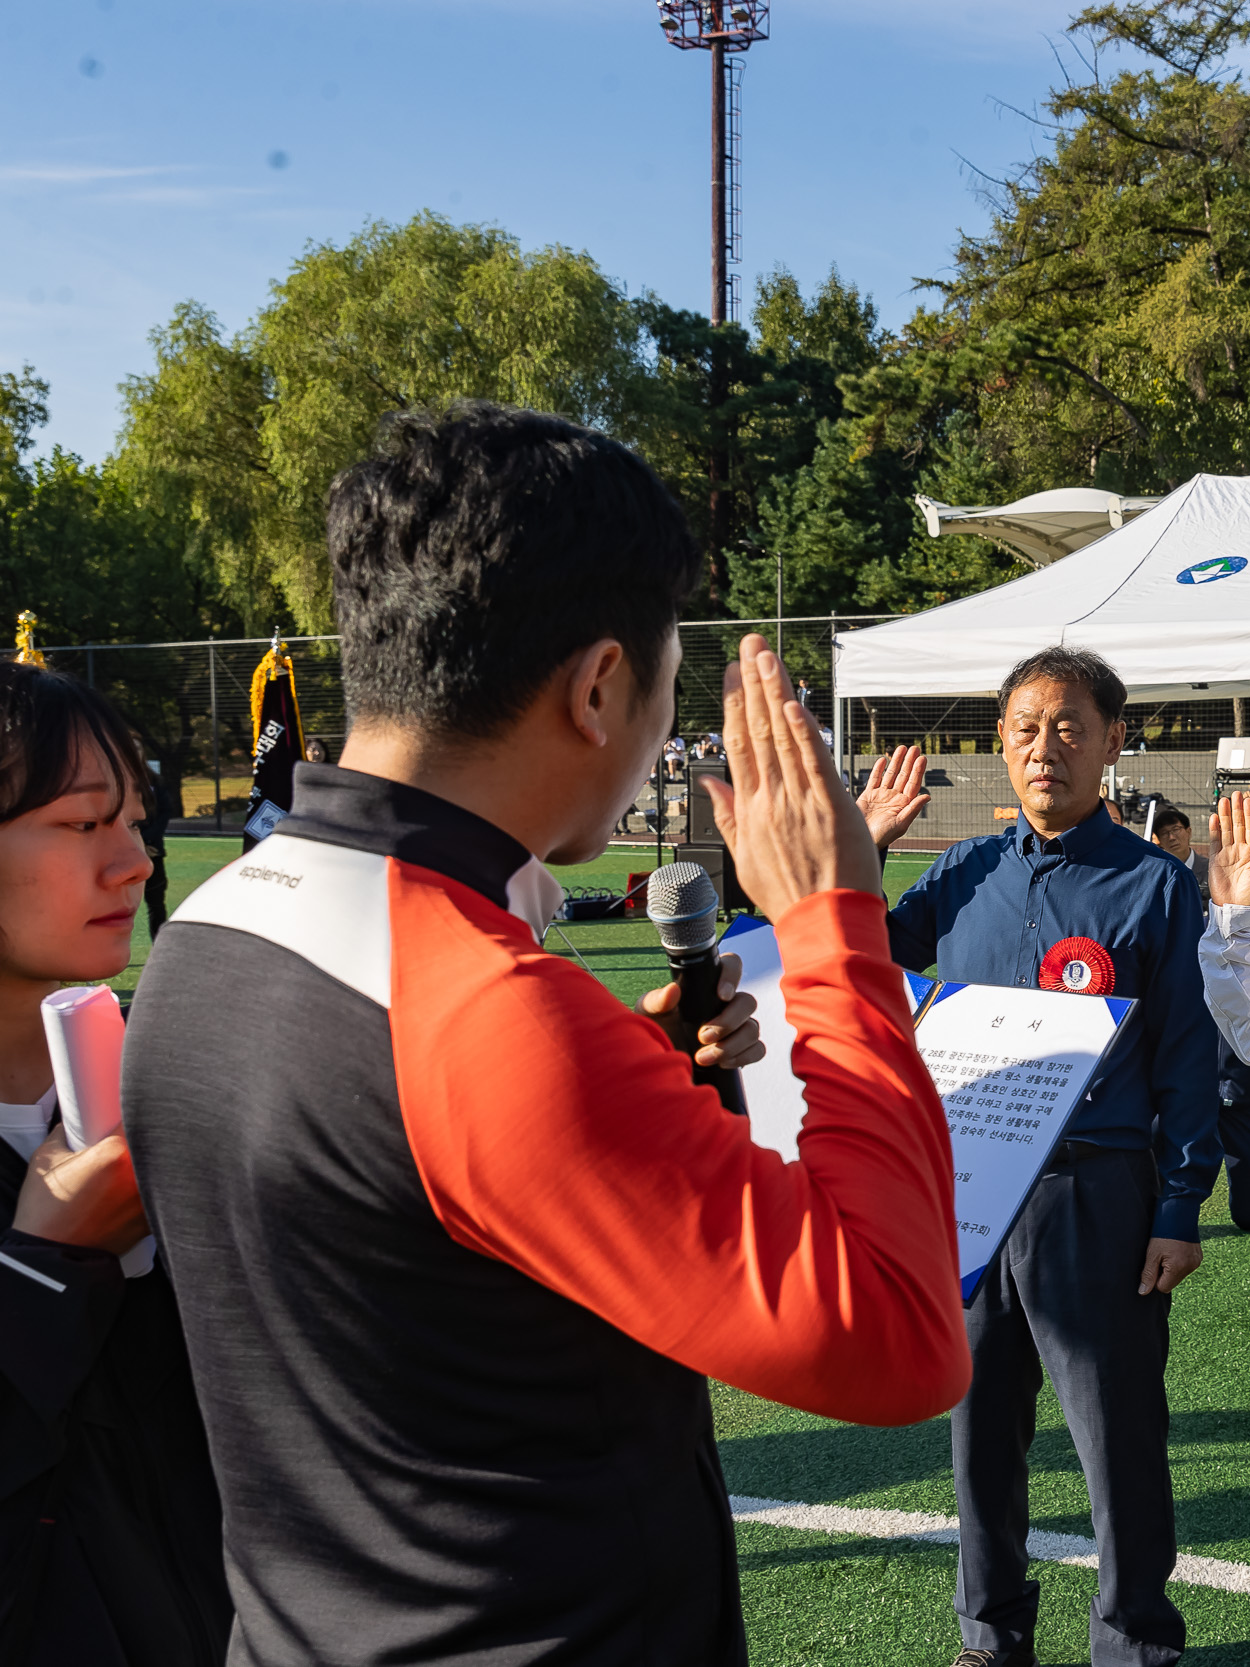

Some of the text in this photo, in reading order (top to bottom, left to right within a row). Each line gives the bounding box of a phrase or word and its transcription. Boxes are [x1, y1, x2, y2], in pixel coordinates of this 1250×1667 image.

[948, 1051, 998, 1064] 광진구청장기
[1001, 1056, 1043, 1070] 축구대회에
[1046, 1061, 1073, 1073] 참가한
[1026, 1074, 1069, 1087] 생활체육을
[976, 1098, 1002, 1109] 다하고
[947, 1109, 981, 1121] 만족하는
[1006, 1117, 1041, 1130] 생활체육
